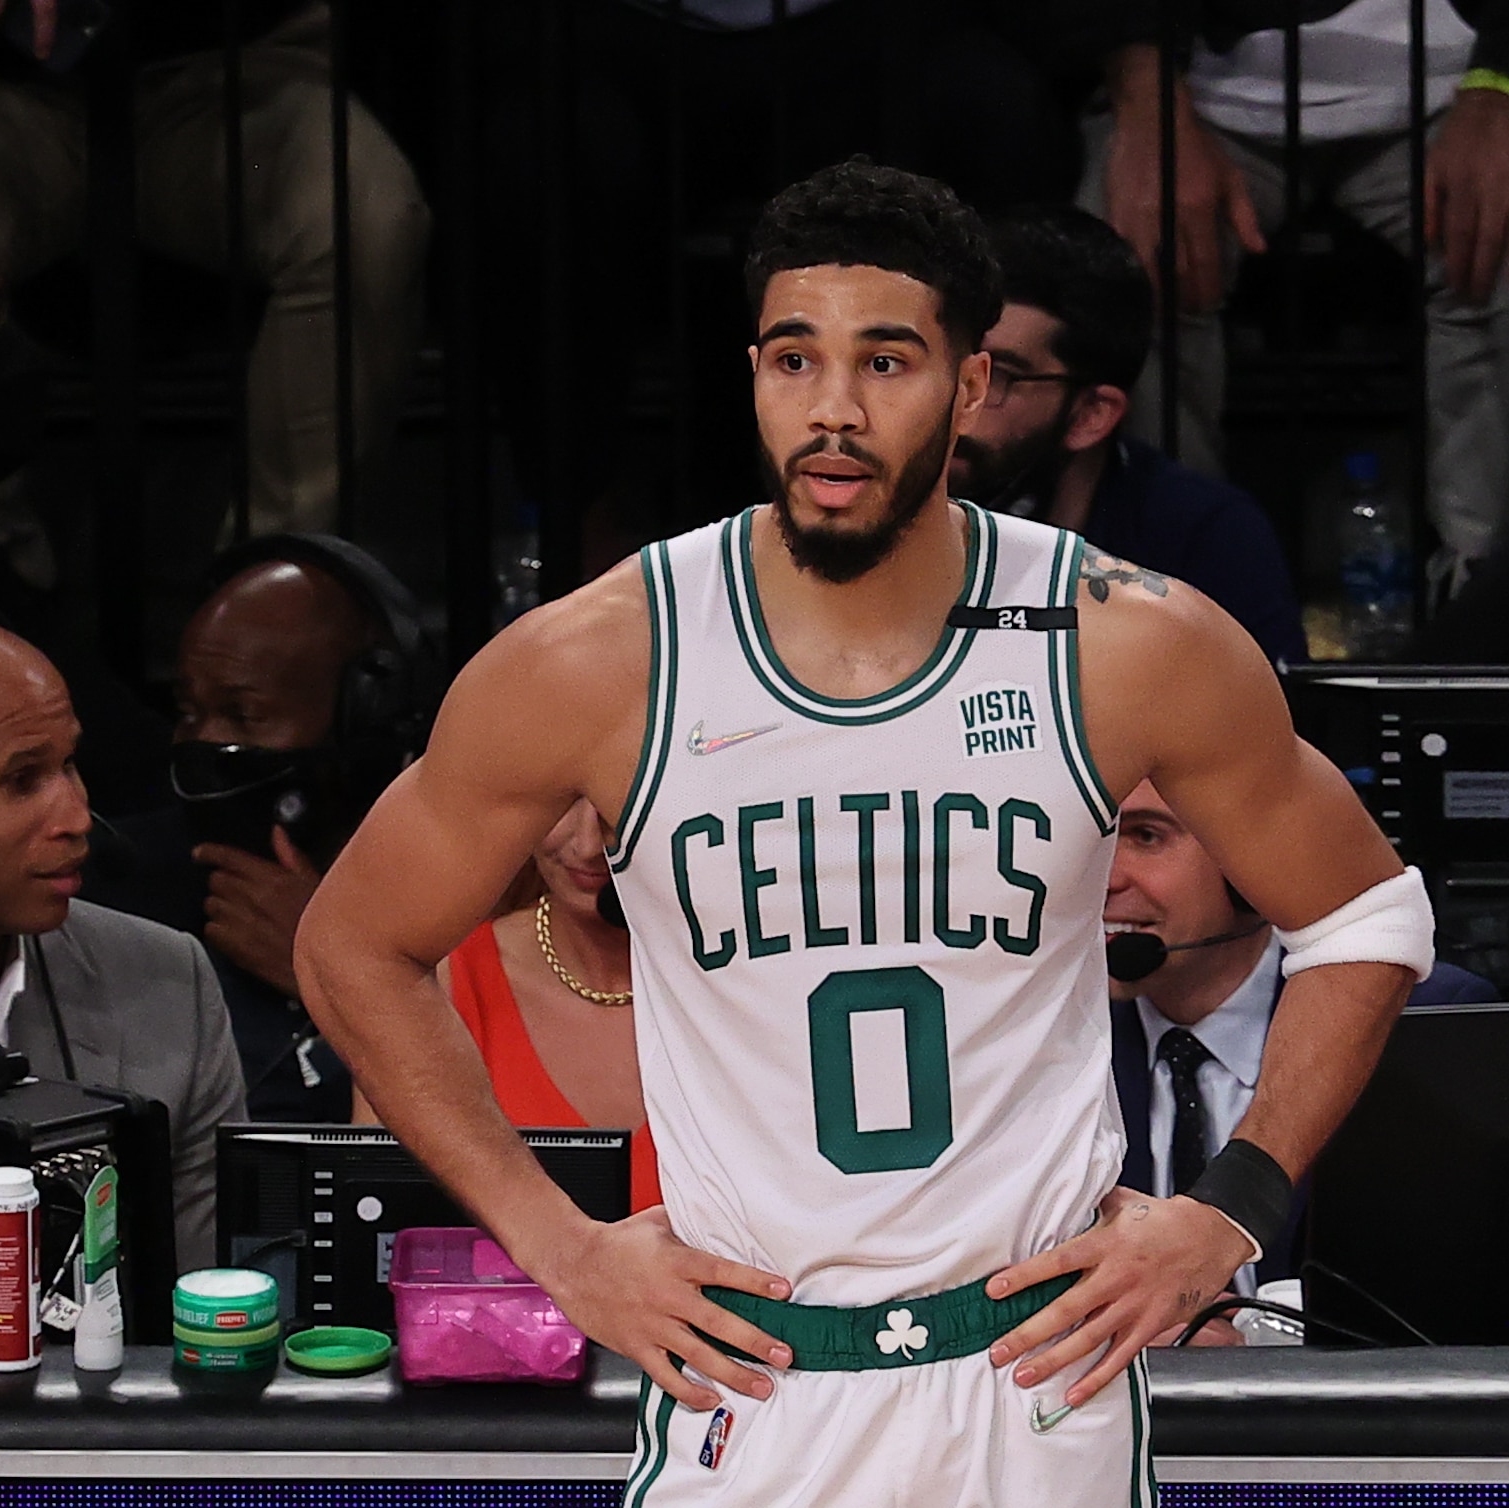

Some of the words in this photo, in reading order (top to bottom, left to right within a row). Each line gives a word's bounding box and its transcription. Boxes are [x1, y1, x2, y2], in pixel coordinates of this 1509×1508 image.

[998, 609, 1027, 629] 24
[960, 689, 1035, 729] VISTA
[965, 724, 1036, 757] PRINT
[670, 790, 1051, 971] CELTICS
[807, 965, 953, 1175] 0
